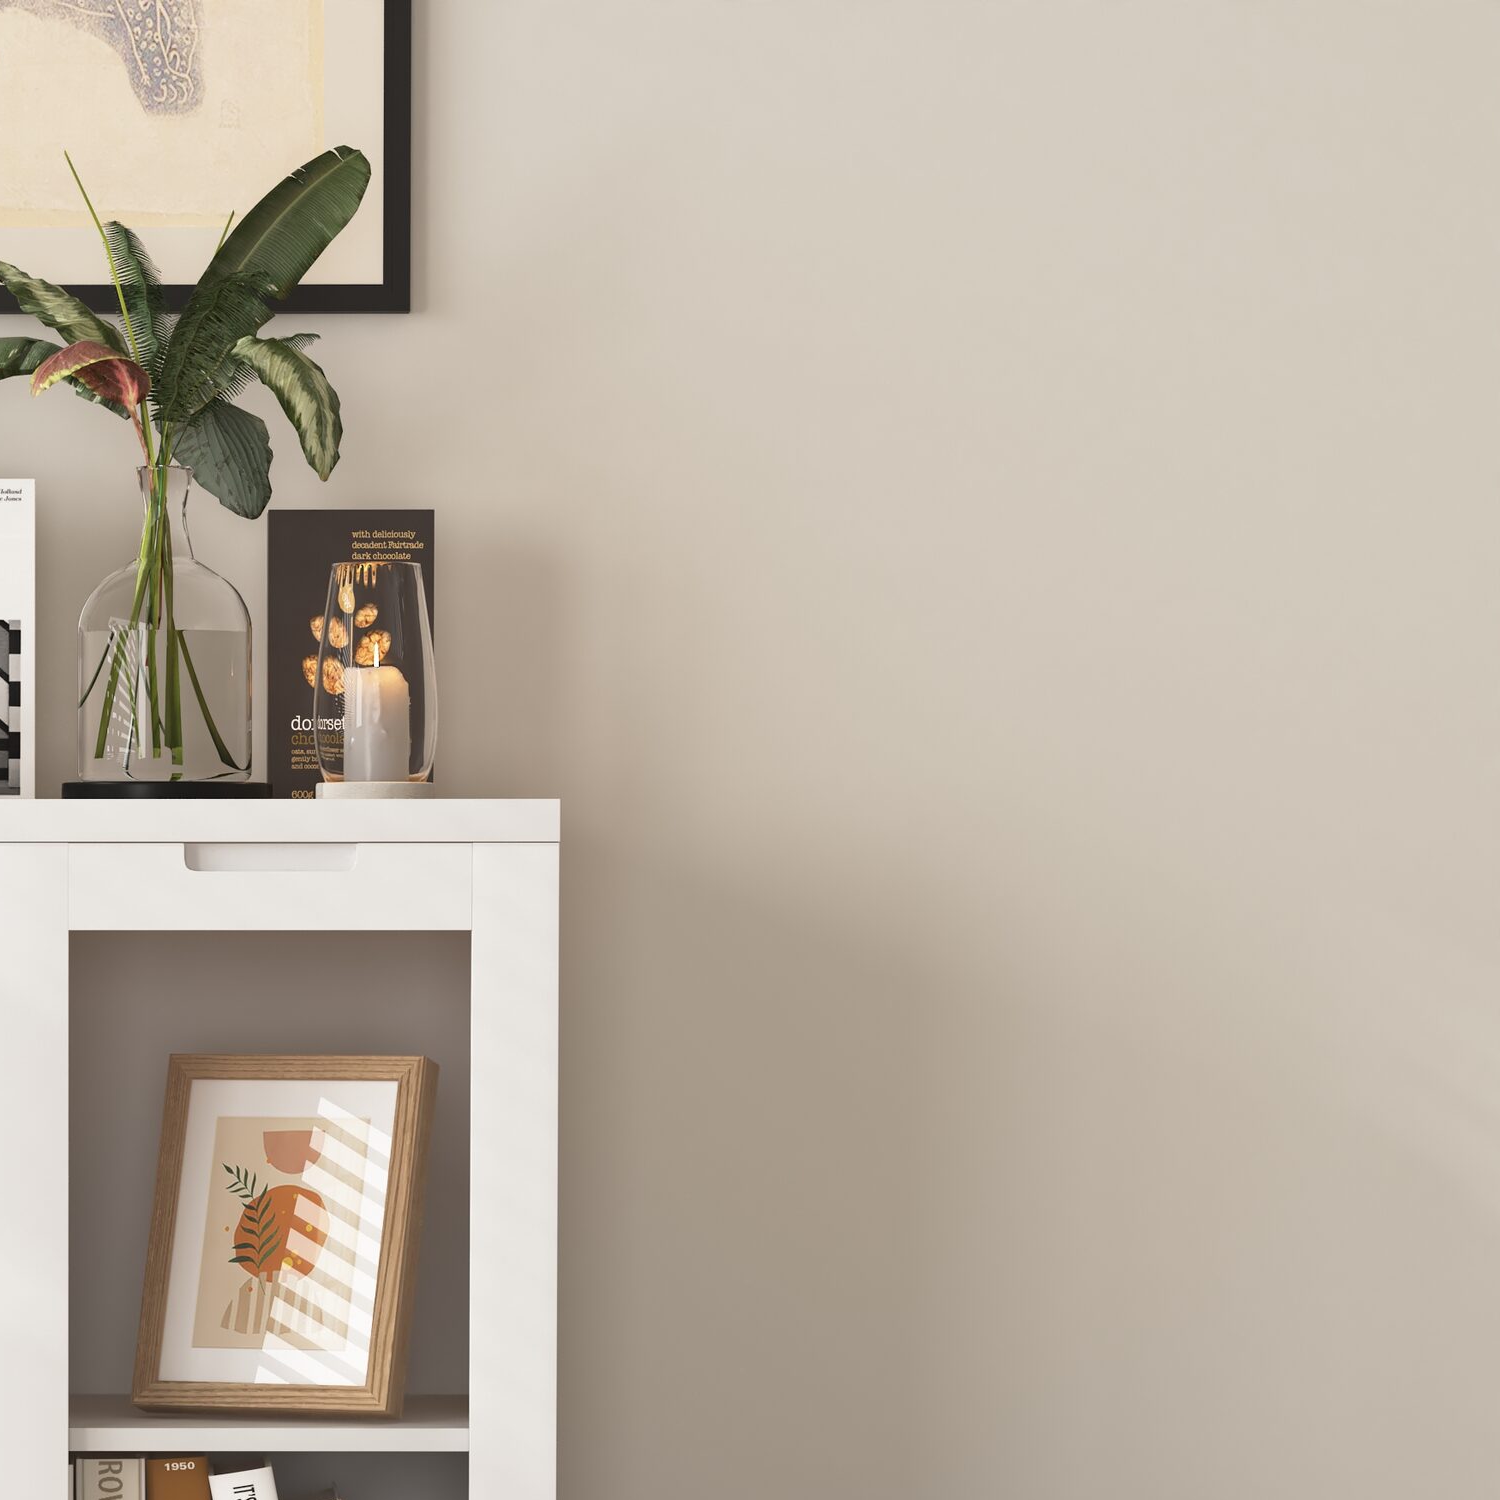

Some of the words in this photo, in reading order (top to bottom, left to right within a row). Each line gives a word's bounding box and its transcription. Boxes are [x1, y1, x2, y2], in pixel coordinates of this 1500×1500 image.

[351, 530, 371, 538] with
[372, 530, 416, 539] deliciously
[351, 541, 387, 549] decadent
[388, 541, 424, 549] Fairtrade
[351, 552, 372, 560] dark
[372, 552, 412, 560] chocolate
[291, 790, 314, 799] 600g
[164, 1462, 196, 1471] 1950
